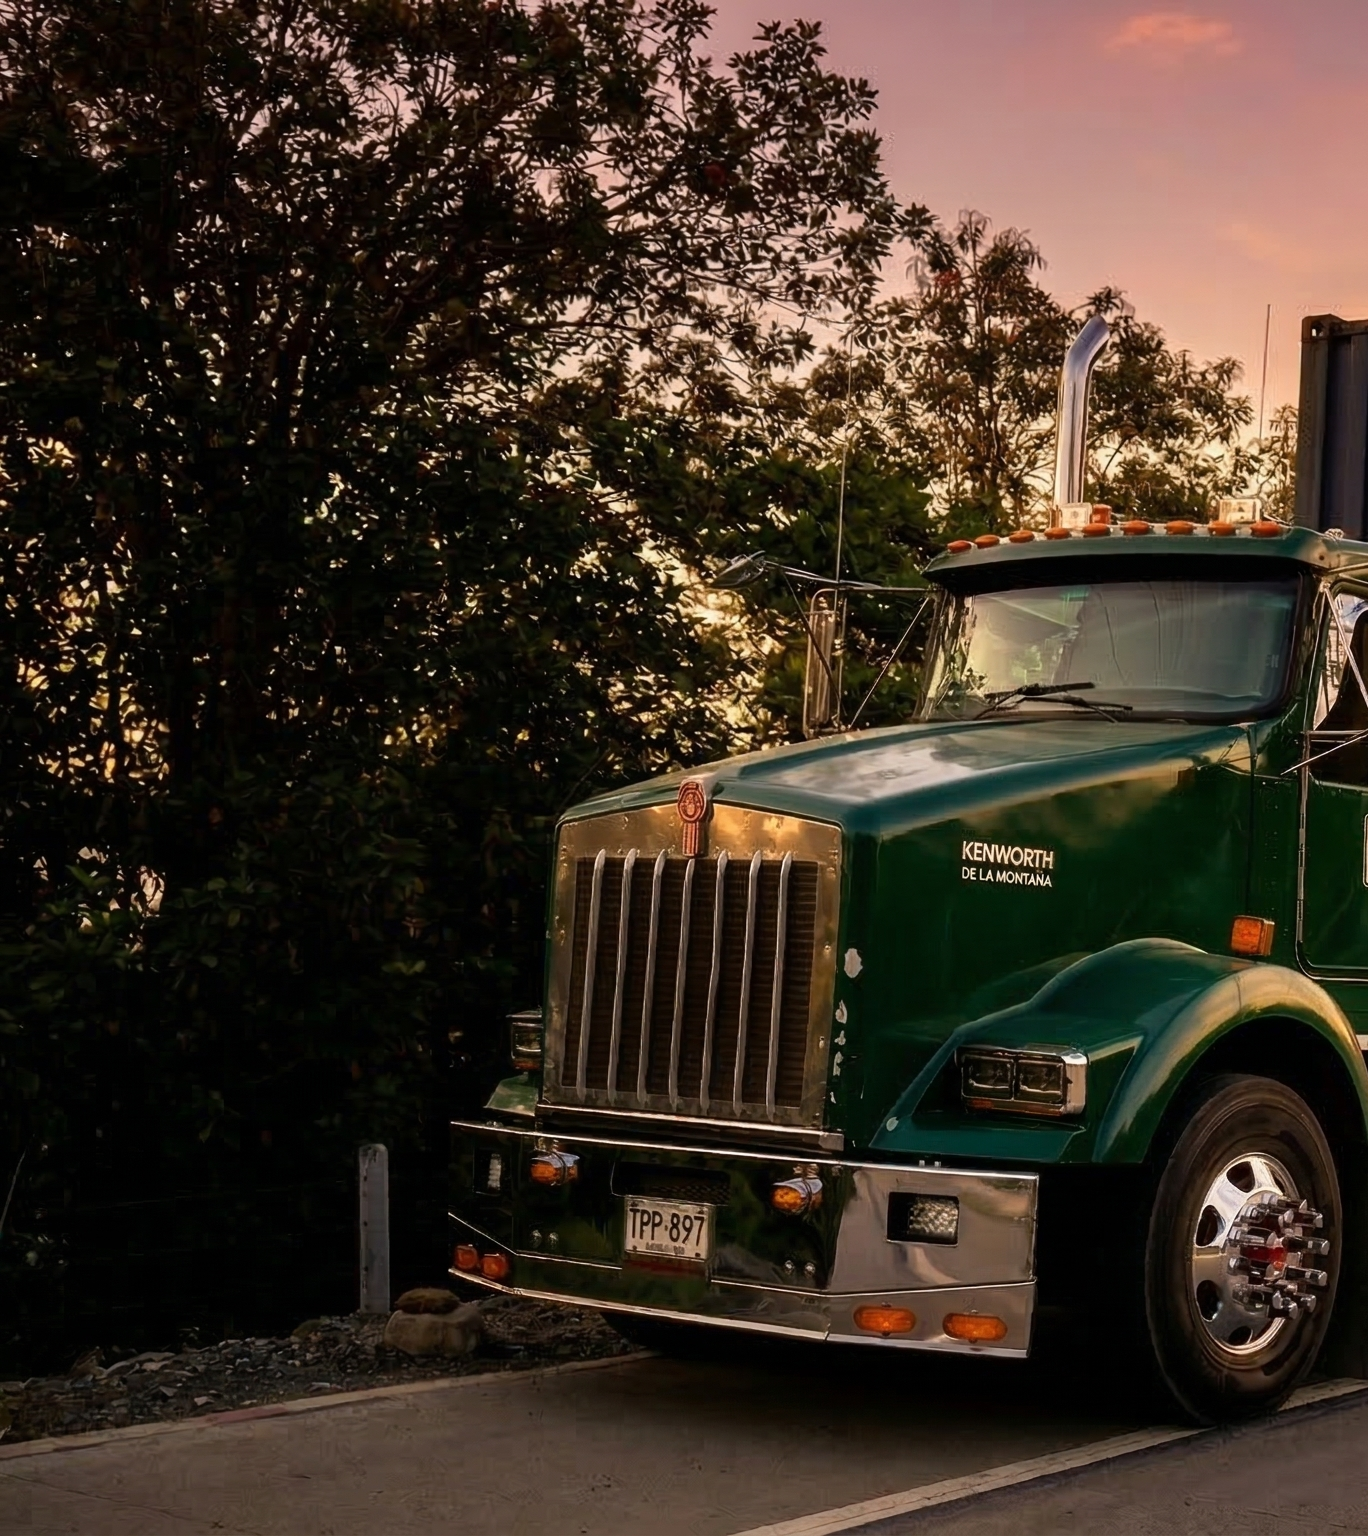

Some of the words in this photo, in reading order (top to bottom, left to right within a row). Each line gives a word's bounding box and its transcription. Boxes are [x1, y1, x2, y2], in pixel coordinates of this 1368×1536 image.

[962, 840, 1054, 869] KENWORTH
[962, 866, 977, 881] DE
[979, 868, 994, 882] LA
